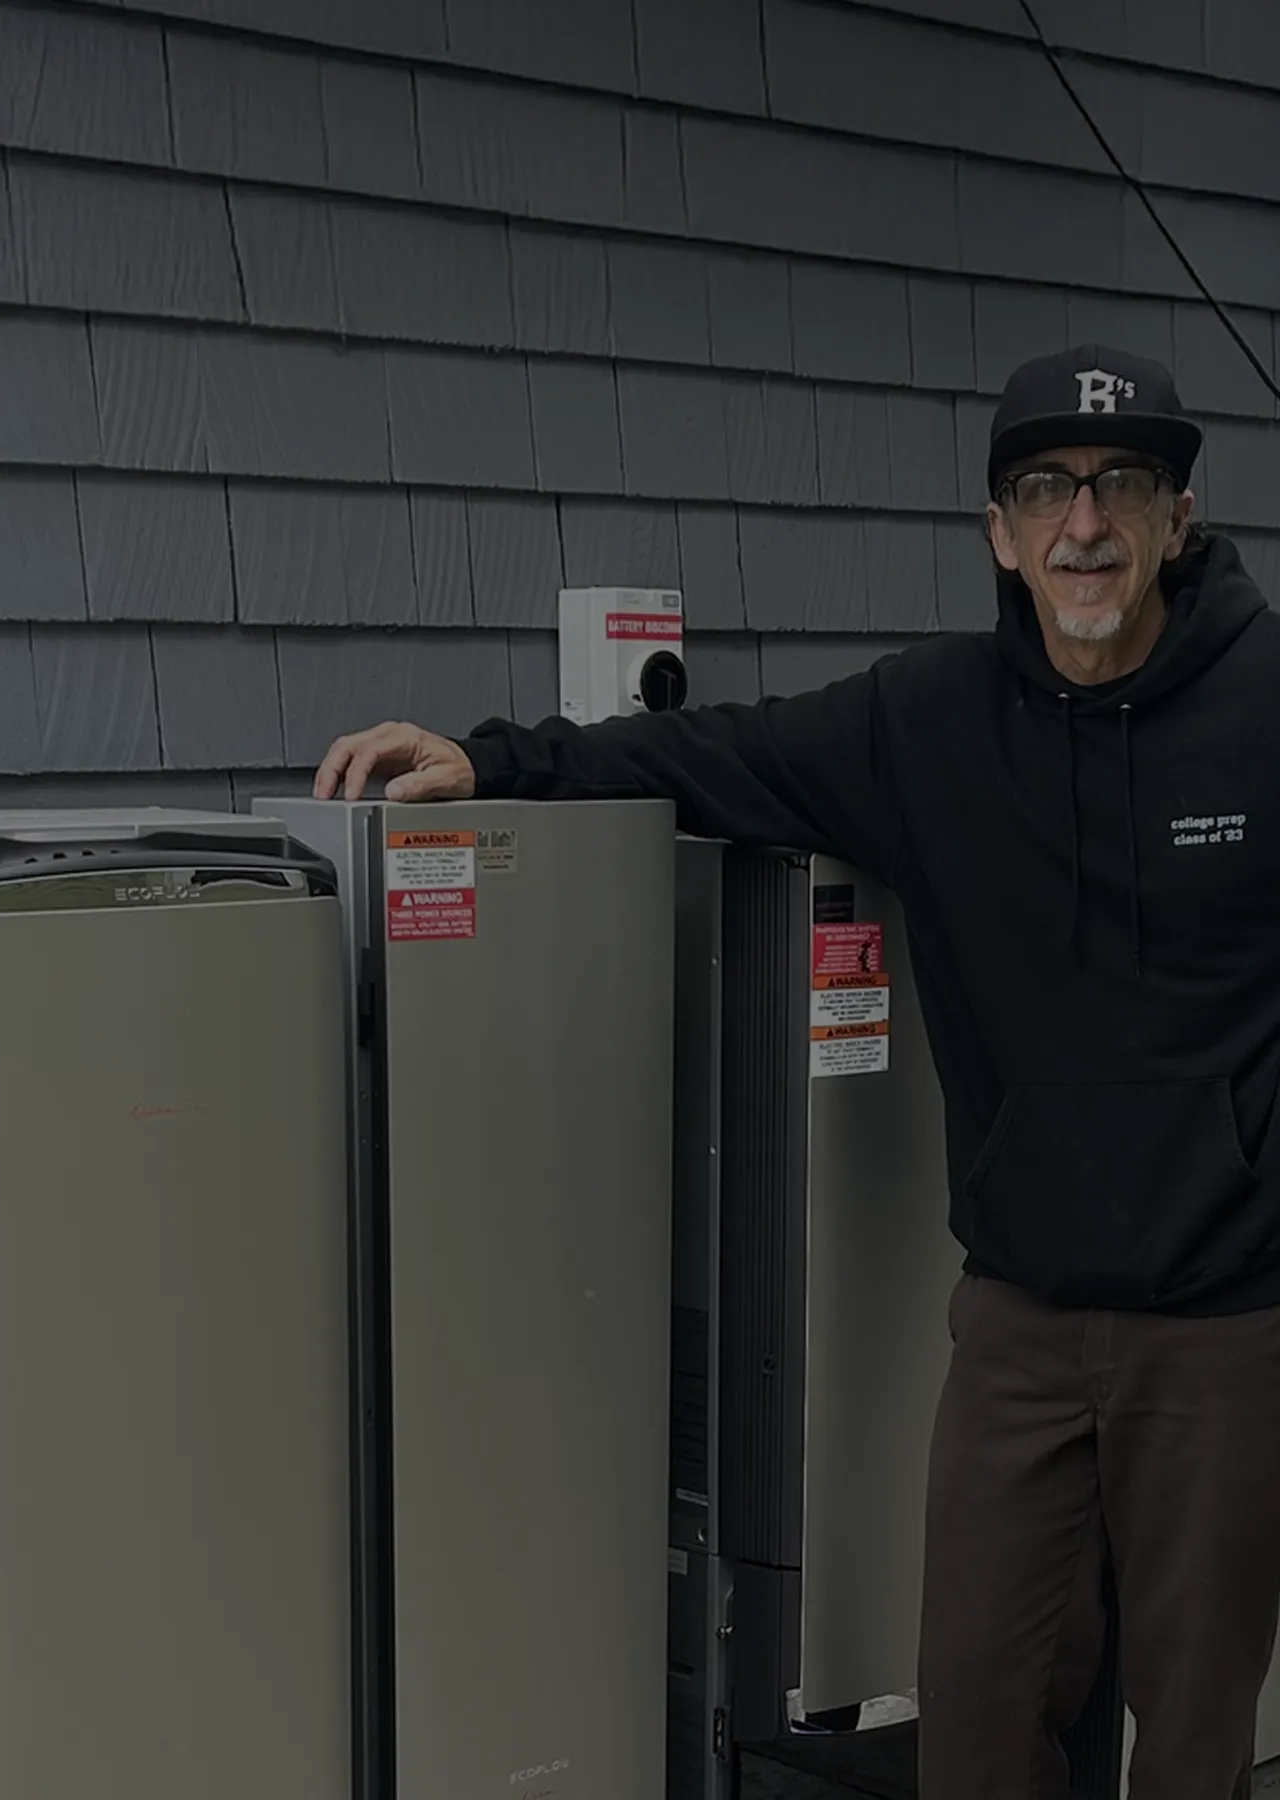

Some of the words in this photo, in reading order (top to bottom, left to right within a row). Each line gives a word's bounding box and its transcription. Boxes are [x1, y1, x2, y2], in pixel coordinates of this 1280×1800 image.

[608, 619, 643, 632] BATTERY
[1171, 816, 1215, 830] college
[1217, 814, 1246, 828] prep
[413, 834, 460, 844] WARNING
[1174, 833, 1207, 846] class
[1209, 830, 1222, 843] of
[413, 892, 464, 905] WARNING
[837, 975, 877, 987] WARNING
[835, 1025, 876, 1036] WARNING
